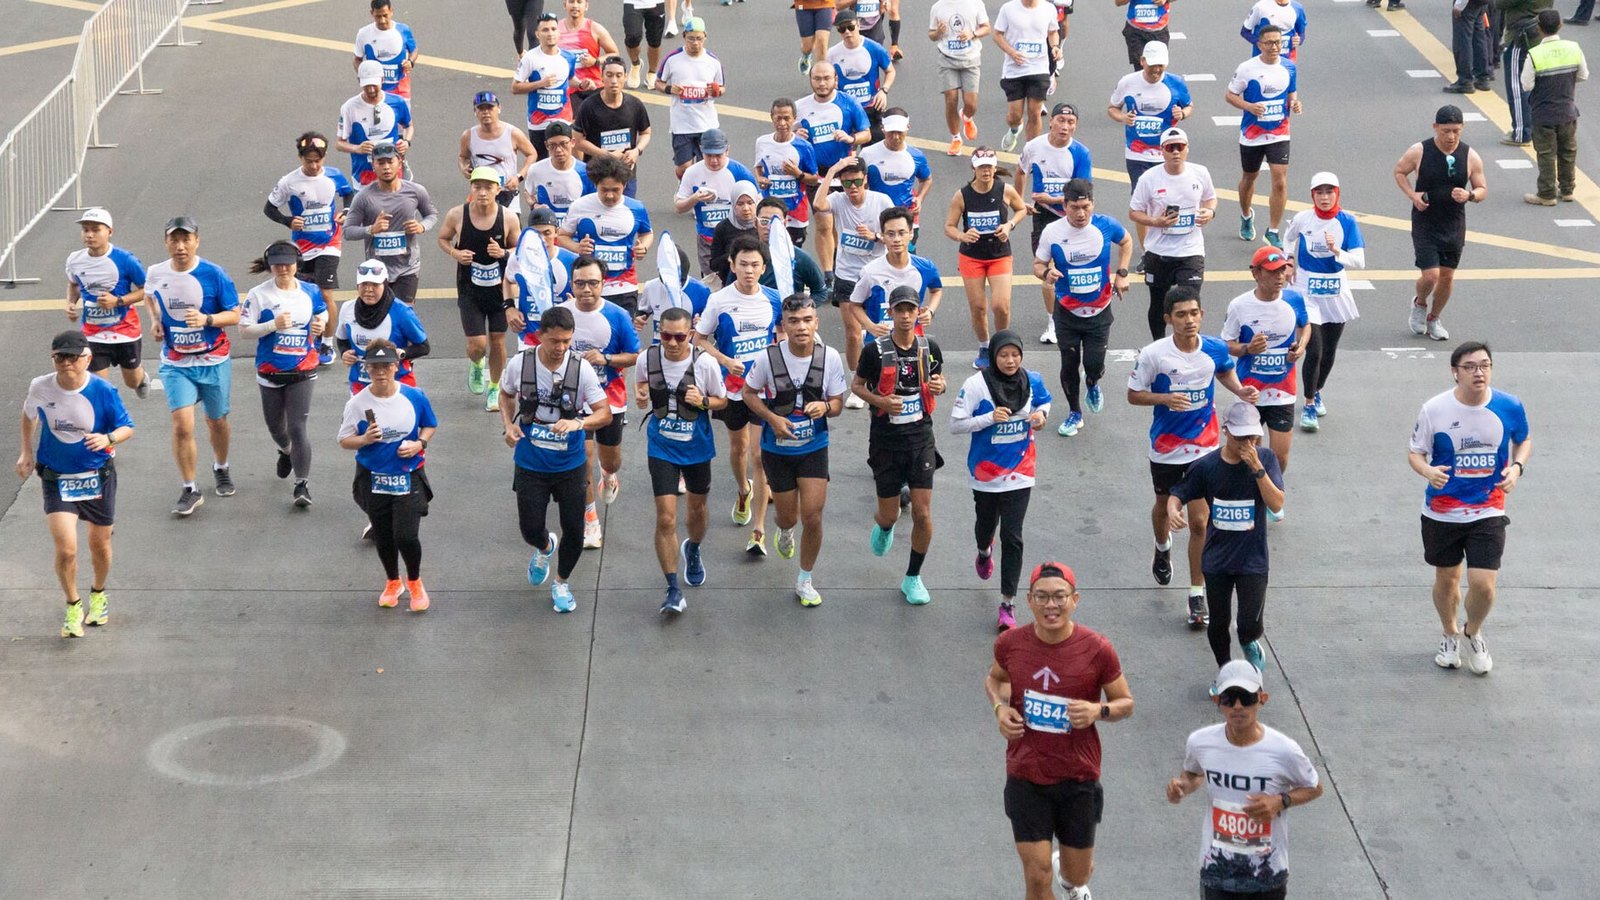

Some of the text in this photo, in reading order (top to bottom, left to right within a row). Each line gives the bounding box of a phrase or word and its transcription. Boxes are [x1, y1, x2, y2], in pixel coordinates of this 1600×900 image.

[683, 88, 706, 98] 45019
[814, 124, 836, 136] 21316
[1135, 121, 1162, 131] 25482
[770, 181, 797, 191] 25449
[970, 216, 998, 228] 25292
[380, 237, 402, 248] 21291
[844, 235, 870, 249] 22177
[597, 251, 624, 263] 22145
[472, 268, 500, 280] 22450
[1070, 274, 1099, 286] 21684
[1309, 279, 1340, 290] 25454
[173, 332, 203, 345] 20102
[277, 335, 307, 348] 20157
[735, 338, 768, 354] 22042
[1254, 355, 1285, 366] 25001
[659, 418, 693, 431] PACER
[996, 422, 1024, 435] 21214
[531, 427, 568, 441] PACER
[1455, 456, 1496, 468] 20085
[61, 477, 99, 492] 25240
[374, 475, 407, 488] 25136
[1215, 506, 1251, 520] 22165
[1024, 701, 1070, 721] 25544
[1206, 769, 1273, 792] RIOT
